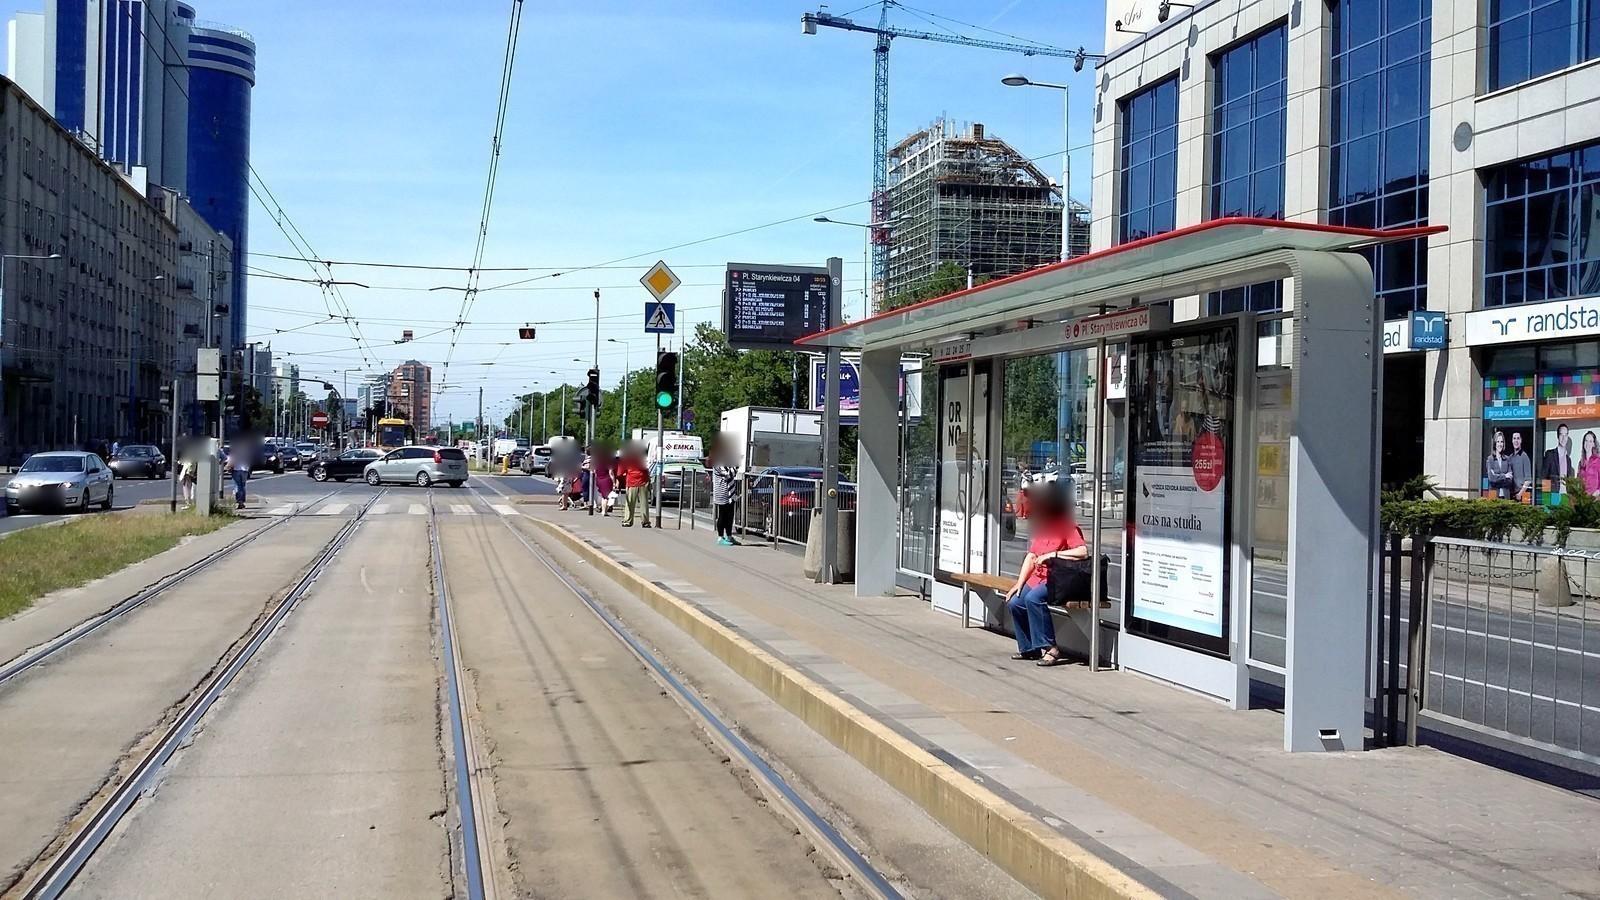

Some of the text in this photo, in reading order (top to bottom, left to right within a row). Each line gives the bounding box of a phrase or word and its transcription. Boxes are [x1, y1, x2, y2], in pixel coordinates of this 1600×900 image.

[751, 274, 792, 282] Starynkiewicza
[1527, 303, 1600, 333] randsta
[1090, 316, 1138, 335] Starynkiewicza
[1138, 314, 1148, 327] 04
[1414, 335, 1443, 344] randstad
[948, 401, 962, 423] OR
[1488, 408, 1530, 417] praca dla Ciebie
[1549, 406, 1597, 417] praca dla Ciebie
[673, 443, 694, 451] EMKA
[1142, 514, 1202, 532] czas na studia
